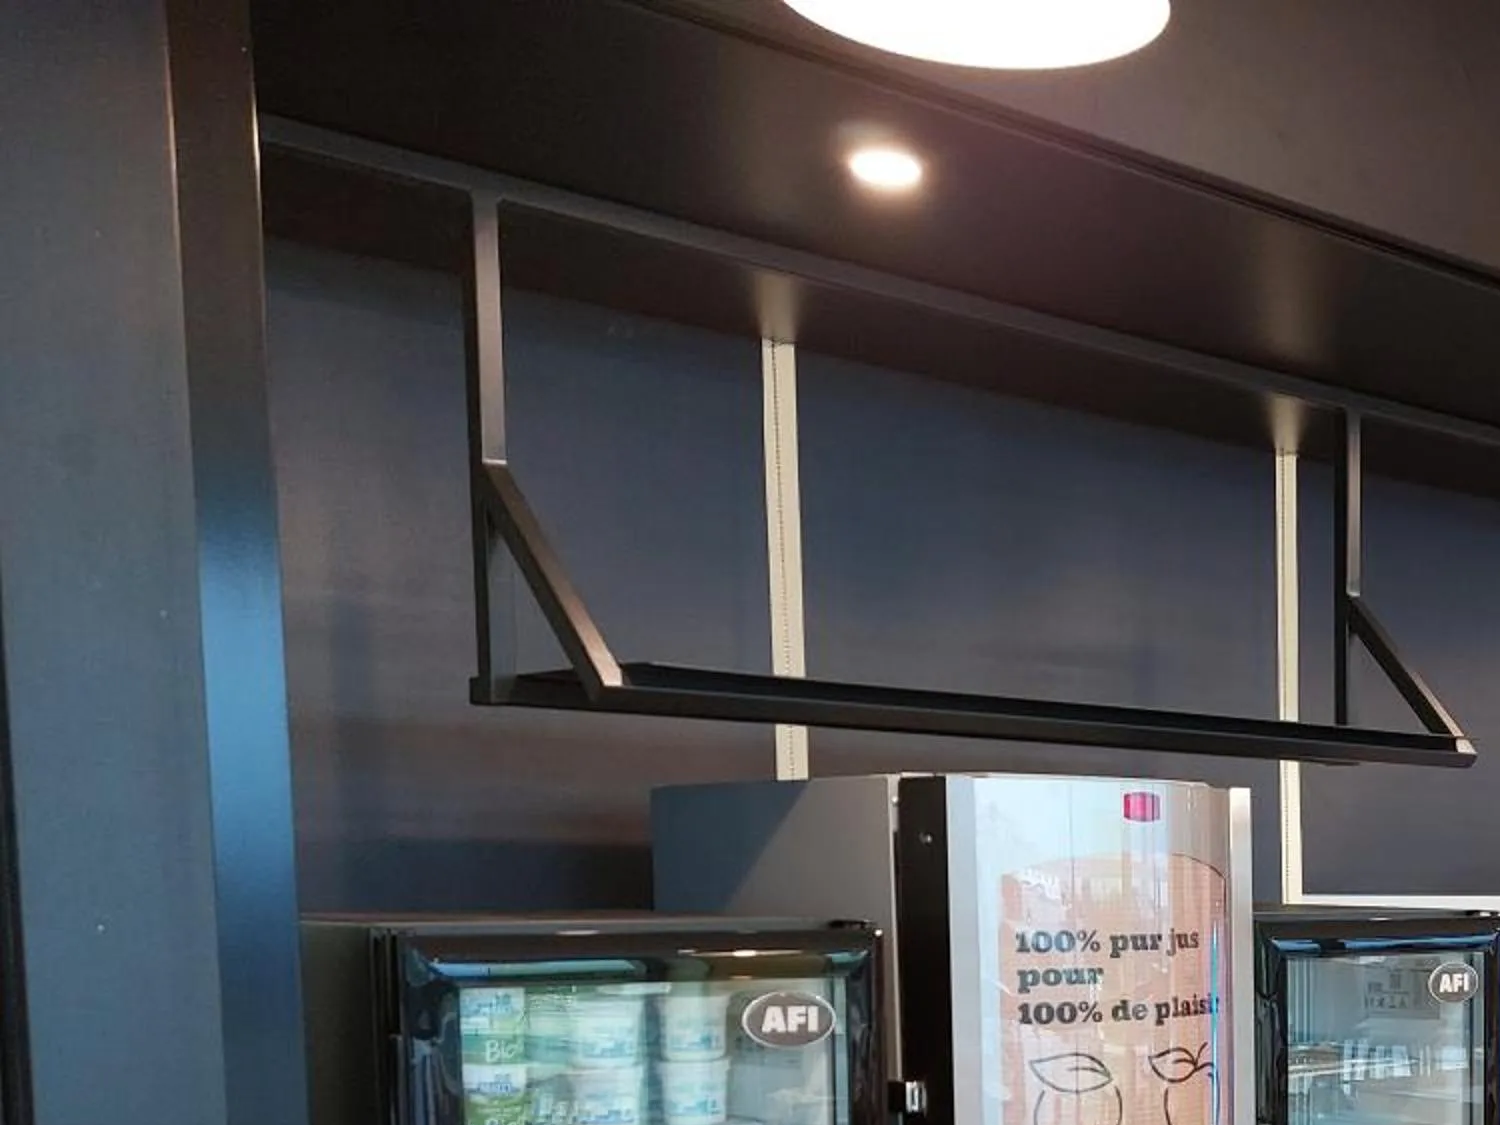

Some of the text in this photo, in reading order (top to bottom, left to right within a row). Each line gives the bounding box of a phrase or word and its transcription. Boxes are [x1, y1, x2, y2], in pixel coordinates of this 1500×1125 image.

[1015, 927, 1199, 958] 100% pur jus
[1017, 967, 1103, 993] pour
[1439, 972, 1470, 993] AFI
[761, 1005, 820, 1033] AFI
[1017, 1001, 1103, 1025] 100%
[1111, 999, 1149, 1021] de
